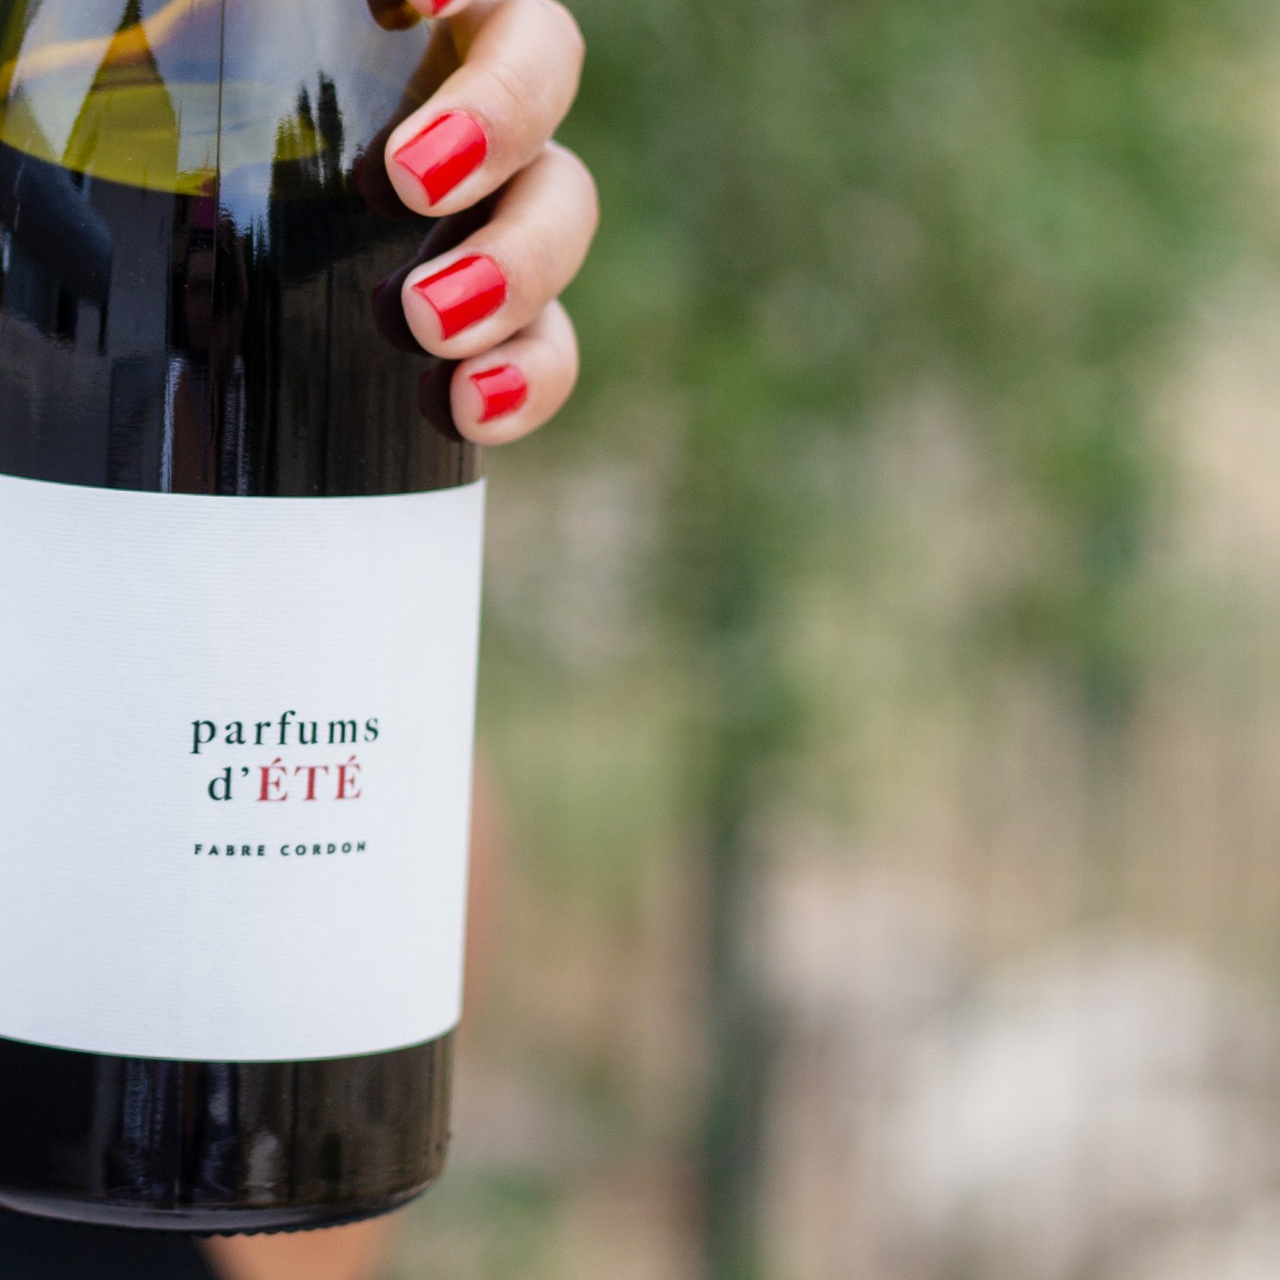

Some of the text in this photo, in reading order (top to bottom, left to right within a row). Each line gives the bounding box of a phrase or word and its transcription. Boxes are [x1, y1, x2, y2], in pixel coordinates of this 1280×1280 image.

[189, 709, 380, 755] parfums
[207, 754, 362, 802] d’ÉTÉ
[194, 841, 366, 857] FABRE CORDON
